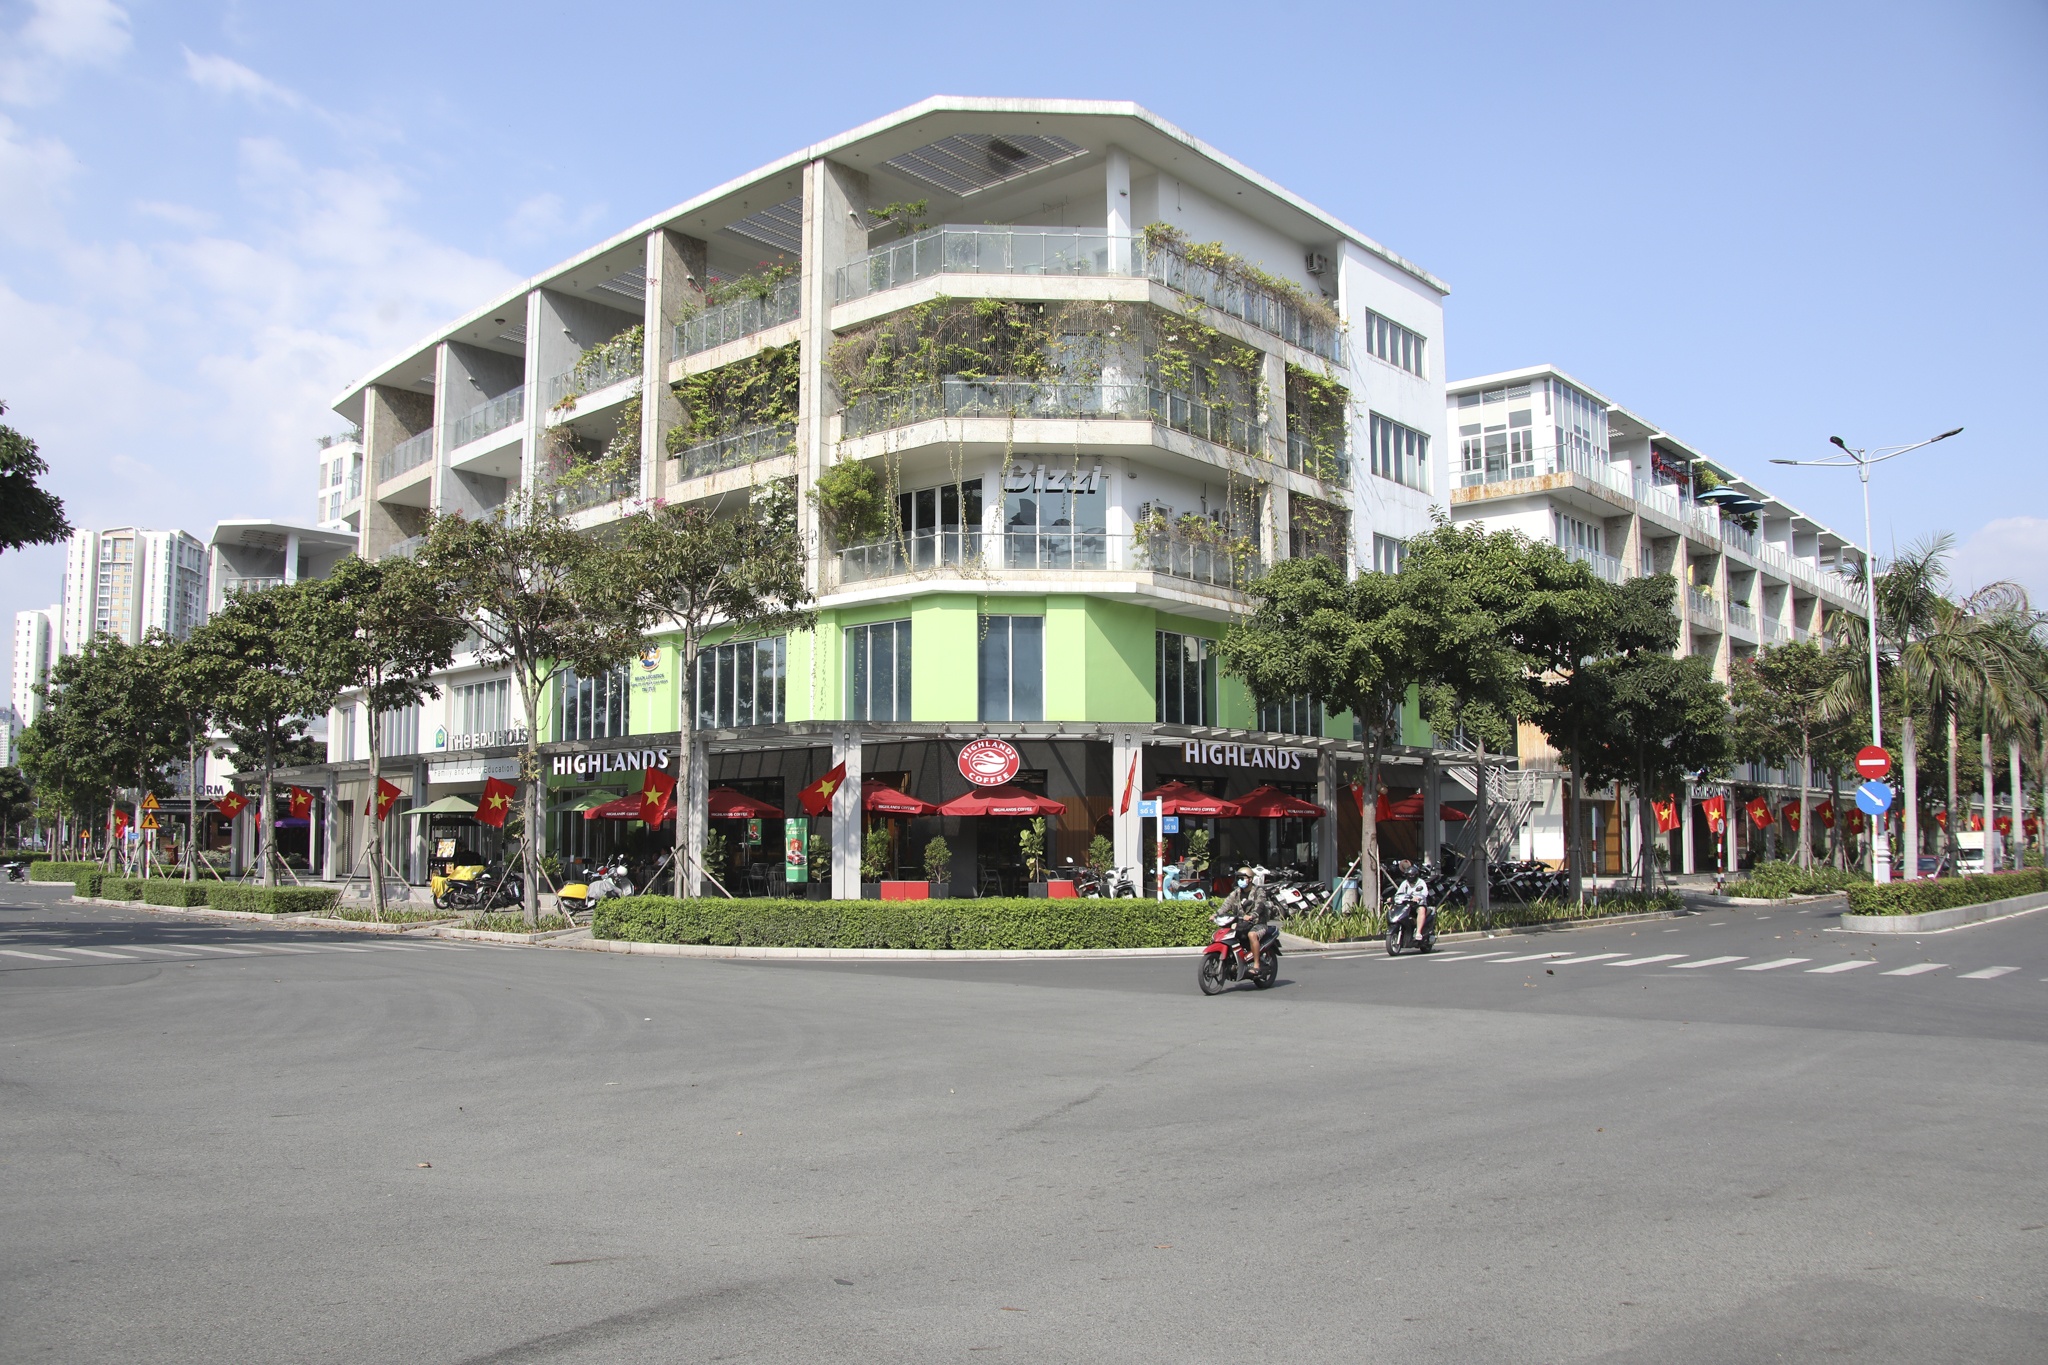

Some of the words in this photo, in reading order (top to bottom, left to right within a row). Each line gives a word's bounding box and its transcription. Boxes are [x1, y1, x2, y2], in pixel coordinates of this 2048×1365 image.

[1004, 459, 1102, 493] Bizzi
[498, 728, 530, 746] HOUS
[961, 741, 1016, 760] HIGHLANDS
[1185, 741, 1301, 770] HIGHLANDS
[484, 764, 514, 774] Education
[553, 748, 669, 775] HIGHLANDS
[968, 772, 1010, 784] COFFEE
